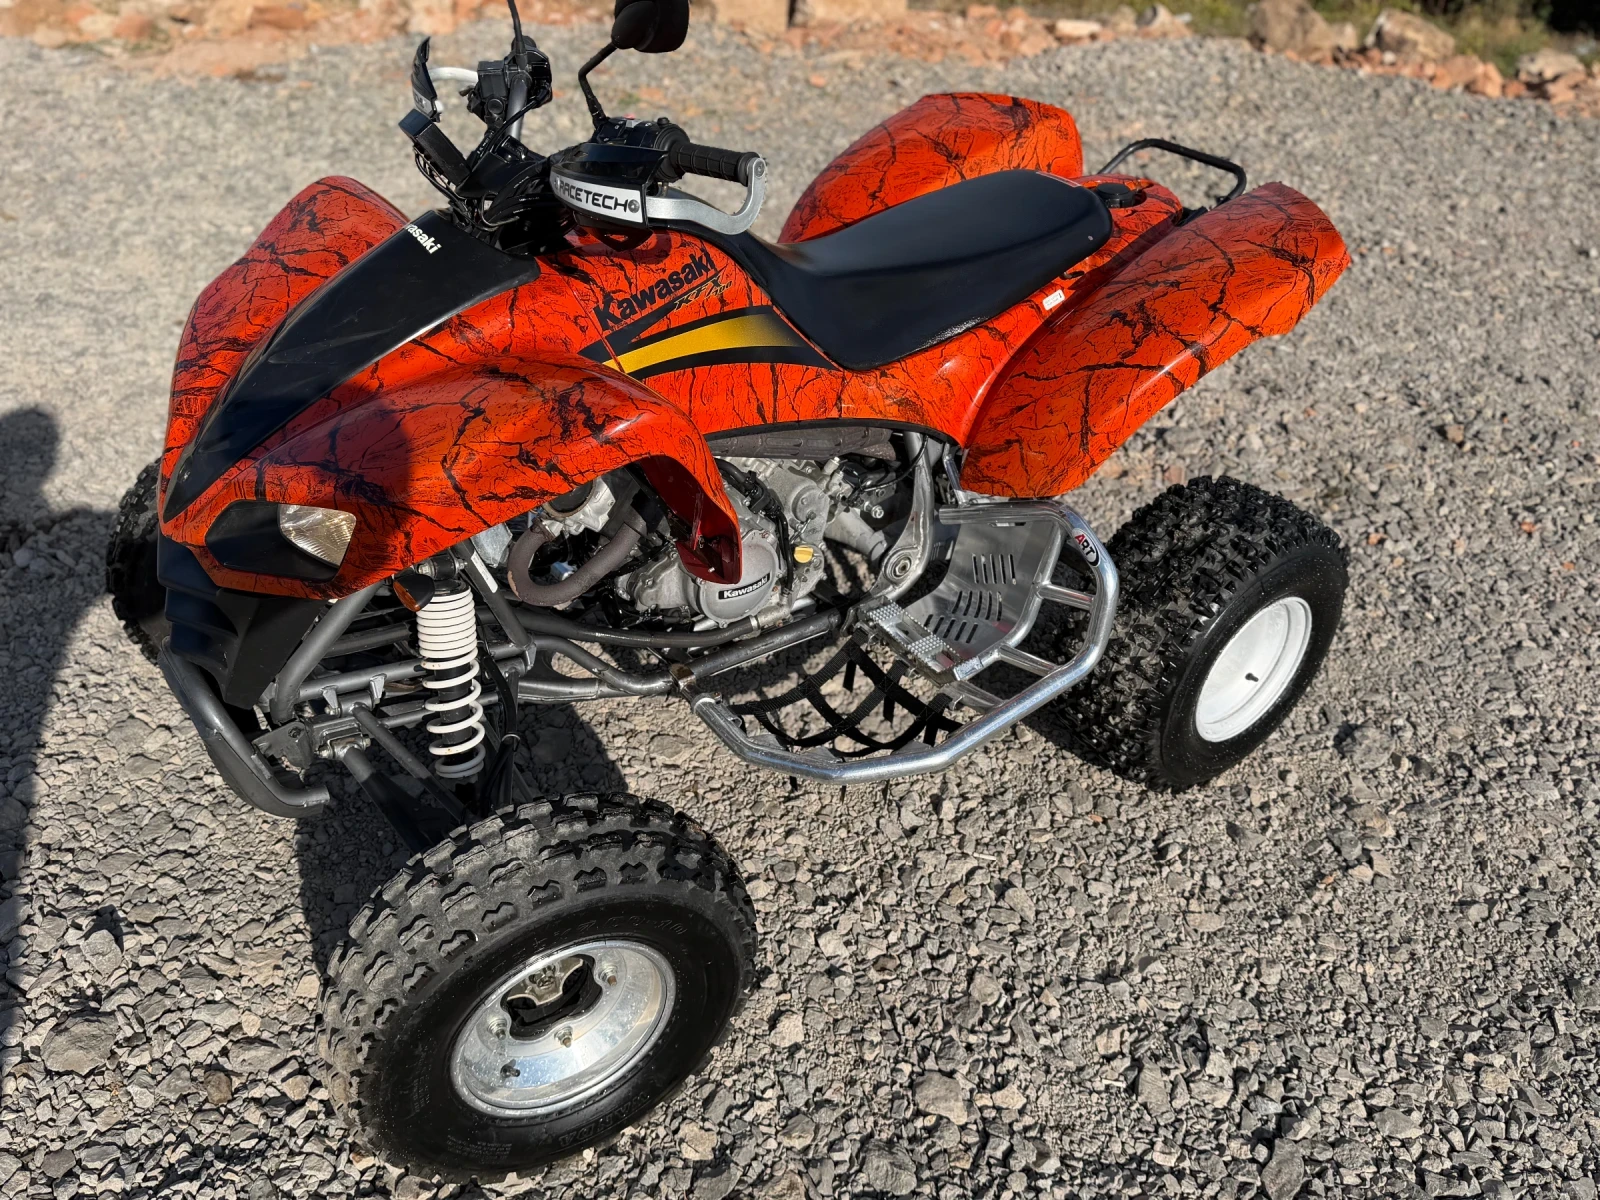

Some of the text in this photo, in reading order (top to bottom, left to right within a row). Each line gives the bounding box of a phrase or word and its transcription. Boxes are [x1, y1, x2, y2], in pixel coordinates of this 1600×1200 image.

[560, 180, 628, 212] RACETECH
[406, 224, 442, 254] asaki
[593, 250, 717, 331] Kawasaki
[1075, 534, 1095, 556] ART
[724, 575, 768, 598] Kawasaki
